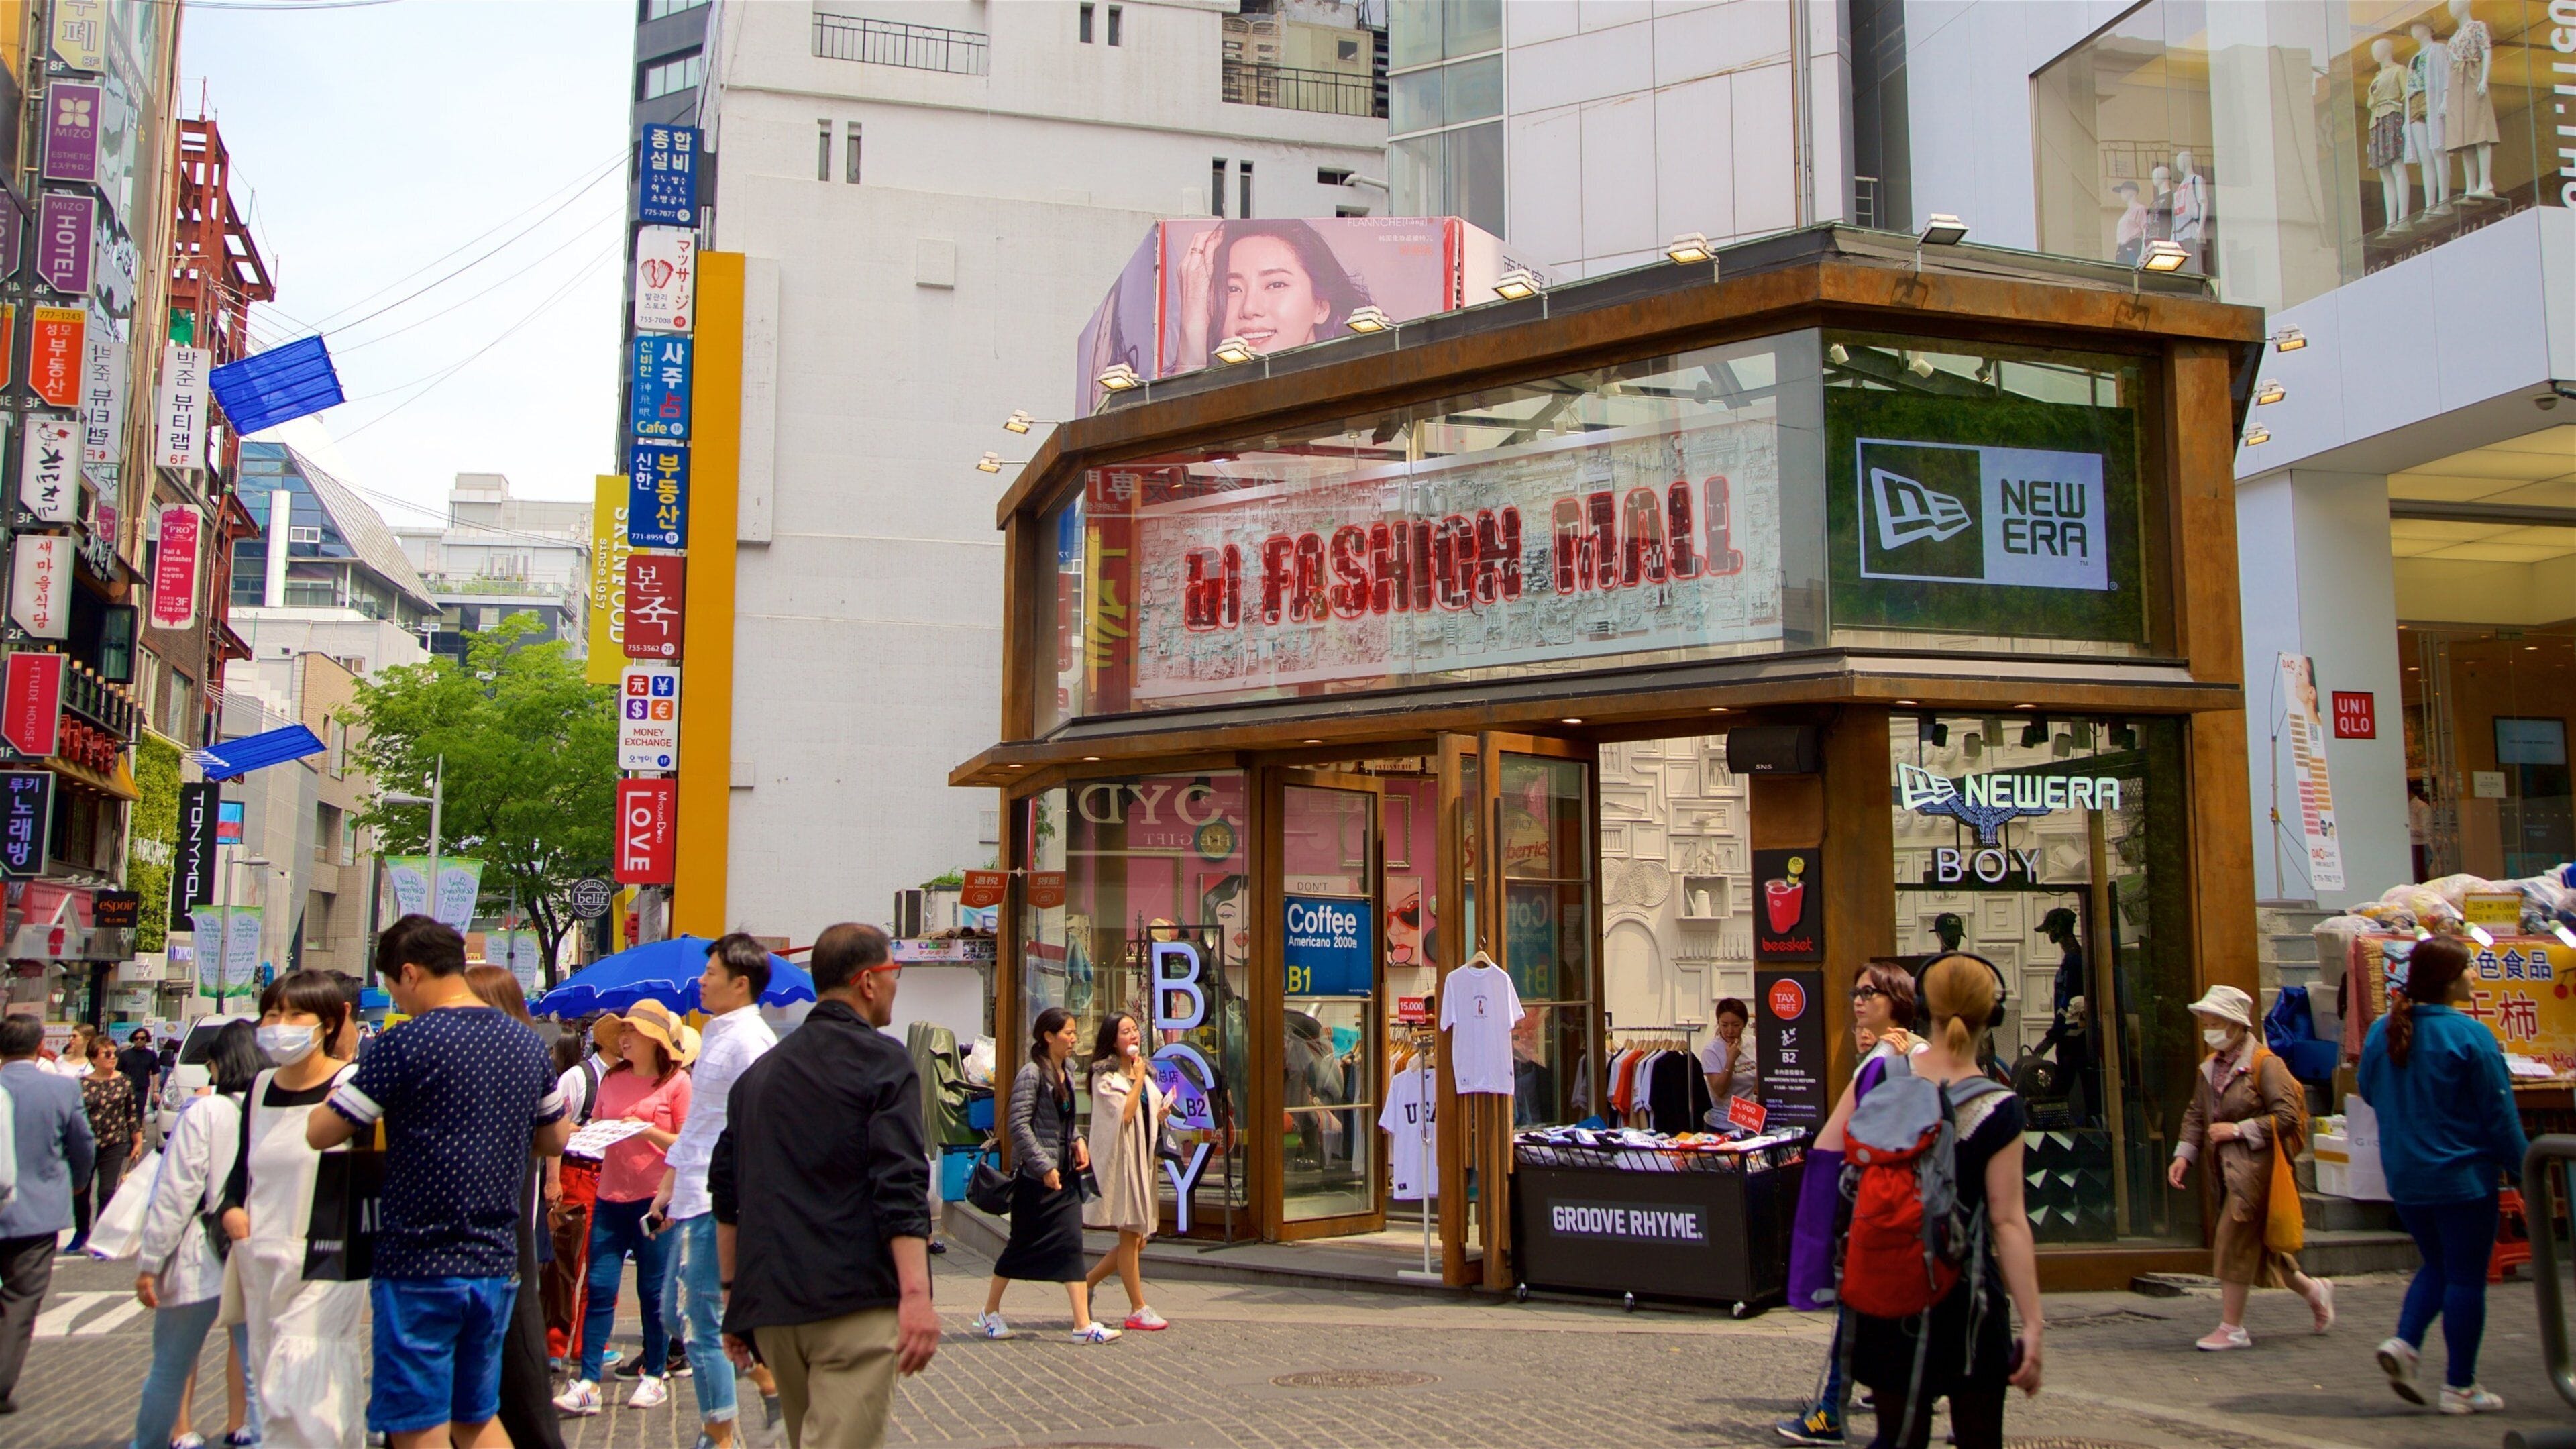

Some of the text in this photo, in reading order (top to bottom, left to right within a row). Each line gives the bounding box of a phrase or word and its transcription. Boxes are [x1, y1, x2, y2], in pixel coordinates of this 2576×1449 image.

[50, 60, 65, 71] 8F
[83, 56, 99, 66] 8F
[54, 127, 91, 139] MIZO
[651, 129, 692, 152] 종합
[51, 151, 92, 161] ESTHETIC
[650, 151, 689, 173] 설비
[51, 201, 85, 212] MIZO
[54, 215, 77, 284] HOTEL
[675, 239, 690, 311] マッサージ
[34, 284, 50, 295] 4F
[644, 293, 667, 301] 발관리
[644, 302, 667, 310] 스포츠
[39, 310, 82, 321] 777-1243
[640, 316, 671, 324] 755-7008
[45, 324, 71, 336] 성모
[639, 341, 653, 378] 신비안
[46, 338, 66, 397] 부동산
[25, 398, 42, 408] 3F
[637, 421, 667, 435] Cafe
[636, 453, 653, 490] 신한
[655, 453, 680, 529] 부동산
[2000, 478, 2086, 519] NEW
[17, 513, 34, 523] 3F
[2002, 517, 2088, 558] ERA
[1263, 514, 1521, 625] FASHION
[1552, 476, 1744, 596] MALL
[595, 538, 608, 609] since 1957
[32, 540, 53, 629] 새마을식당
[176, 597, 189, 606] 3F
[8, 629, 24, 640] 2F
[627, 644, 660, 652] 755-3562
[631, 679, 645, 692] 元
[24, 666, 40, 742] ETUDE HOUSE
[2338, 698, 2366, 714] UNI
[2339, 716, 2370, 734] QLO
[633, 728, 665, 737] MONEY
[625, 738, 672, 747] EXCHANGE
[9, 777, 40, 793] 루키
[7, 796, 34, 865] 노래방
[624, 791, 652, 871] LOVE
[184, 790, 205, 922] TONYMOLY
[1937, 848, 2041, 883] BOY
[580, 881, 604, 890] believe
[1297, 881, 1328, 891] DON'T
[578, 893, 607, 904] belif
[99, 899, 136, 913] espoir
[1287, 903, 1357, 935] Coffee
[1288, 936, 1331, 948] Americano
[1762, 937, 1814, 952] beesket
[2469, 949, 2552, 979] 色食品
[1288, 965, 1311, 993] B1
[1774, 993, 1796, 1003] TAX
[1776, 1004, 1796, 1012] FREE
[1782, 1052, 1796, 1063] B2
[1155, 1069, 1179, 1083] 总店
[1186, 1098, 1207, 1117] B2
[1552, 1205, 1626, 1236] GROOVE
